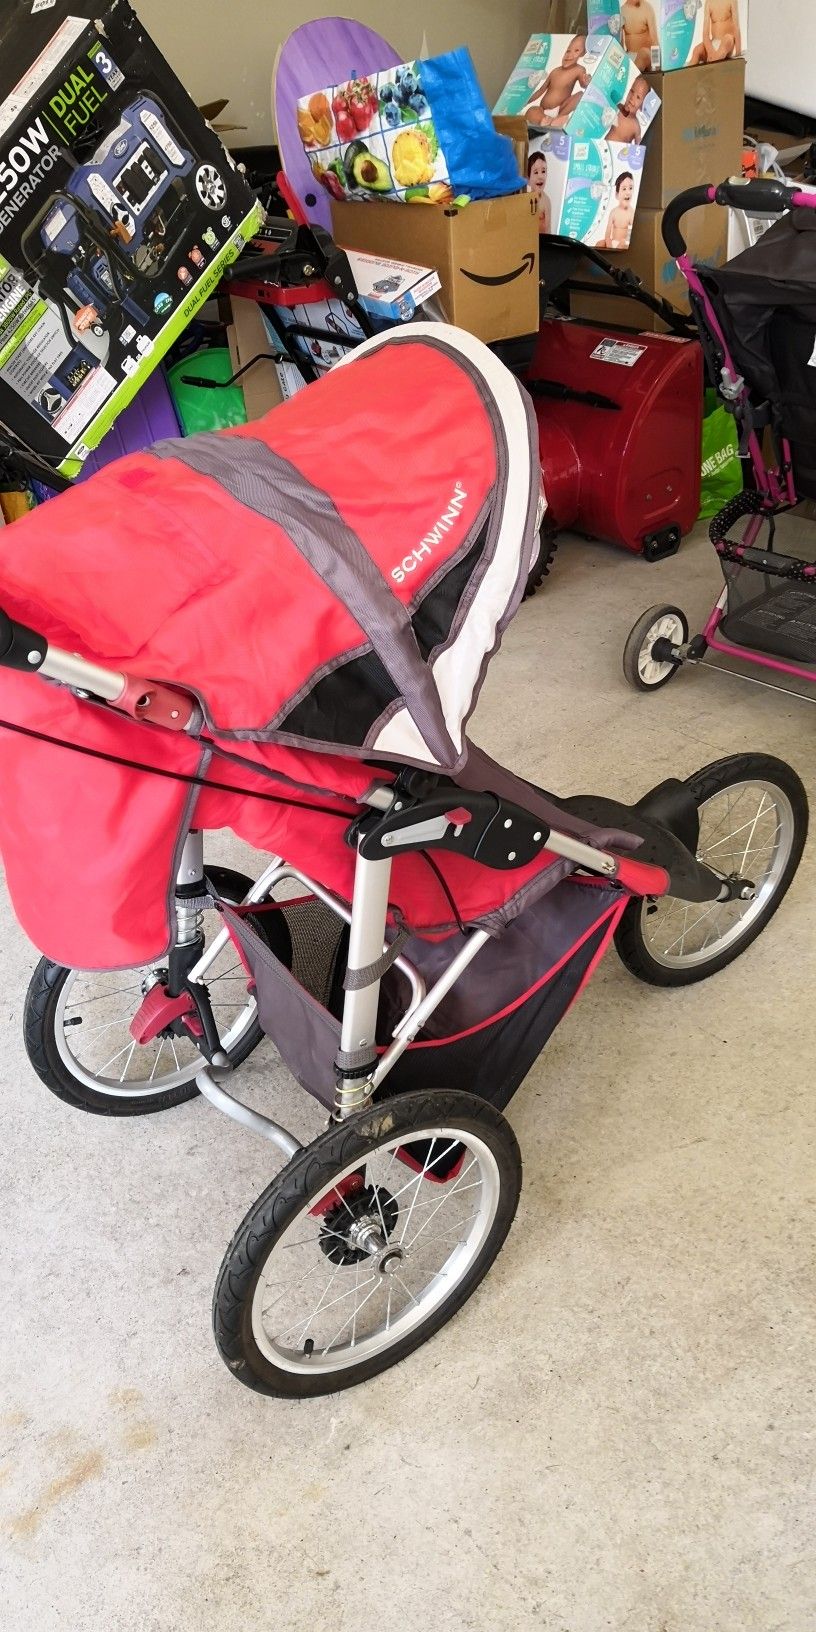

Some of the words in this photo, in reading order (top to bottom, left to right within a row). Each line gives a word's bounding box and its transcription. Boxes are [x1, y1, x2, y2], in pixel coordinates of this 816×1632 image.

[95, 52, 112, 74] 3
[49, 66, 94, 118] DUAL
[64, 86, 108, 136] FUEL
[0, 117, 49, 201] 50W
[558, 136, 565, 146] 5
[634, 146, 641, 157] 5
[183, 295, 200, 317] DUAL
[198, 275, 214, 296] FUEL
[213, 248, 234, 278] SERIES
[717, 443, 736, 467] BAG
[390, 489, 468, 583] SCHWINN
